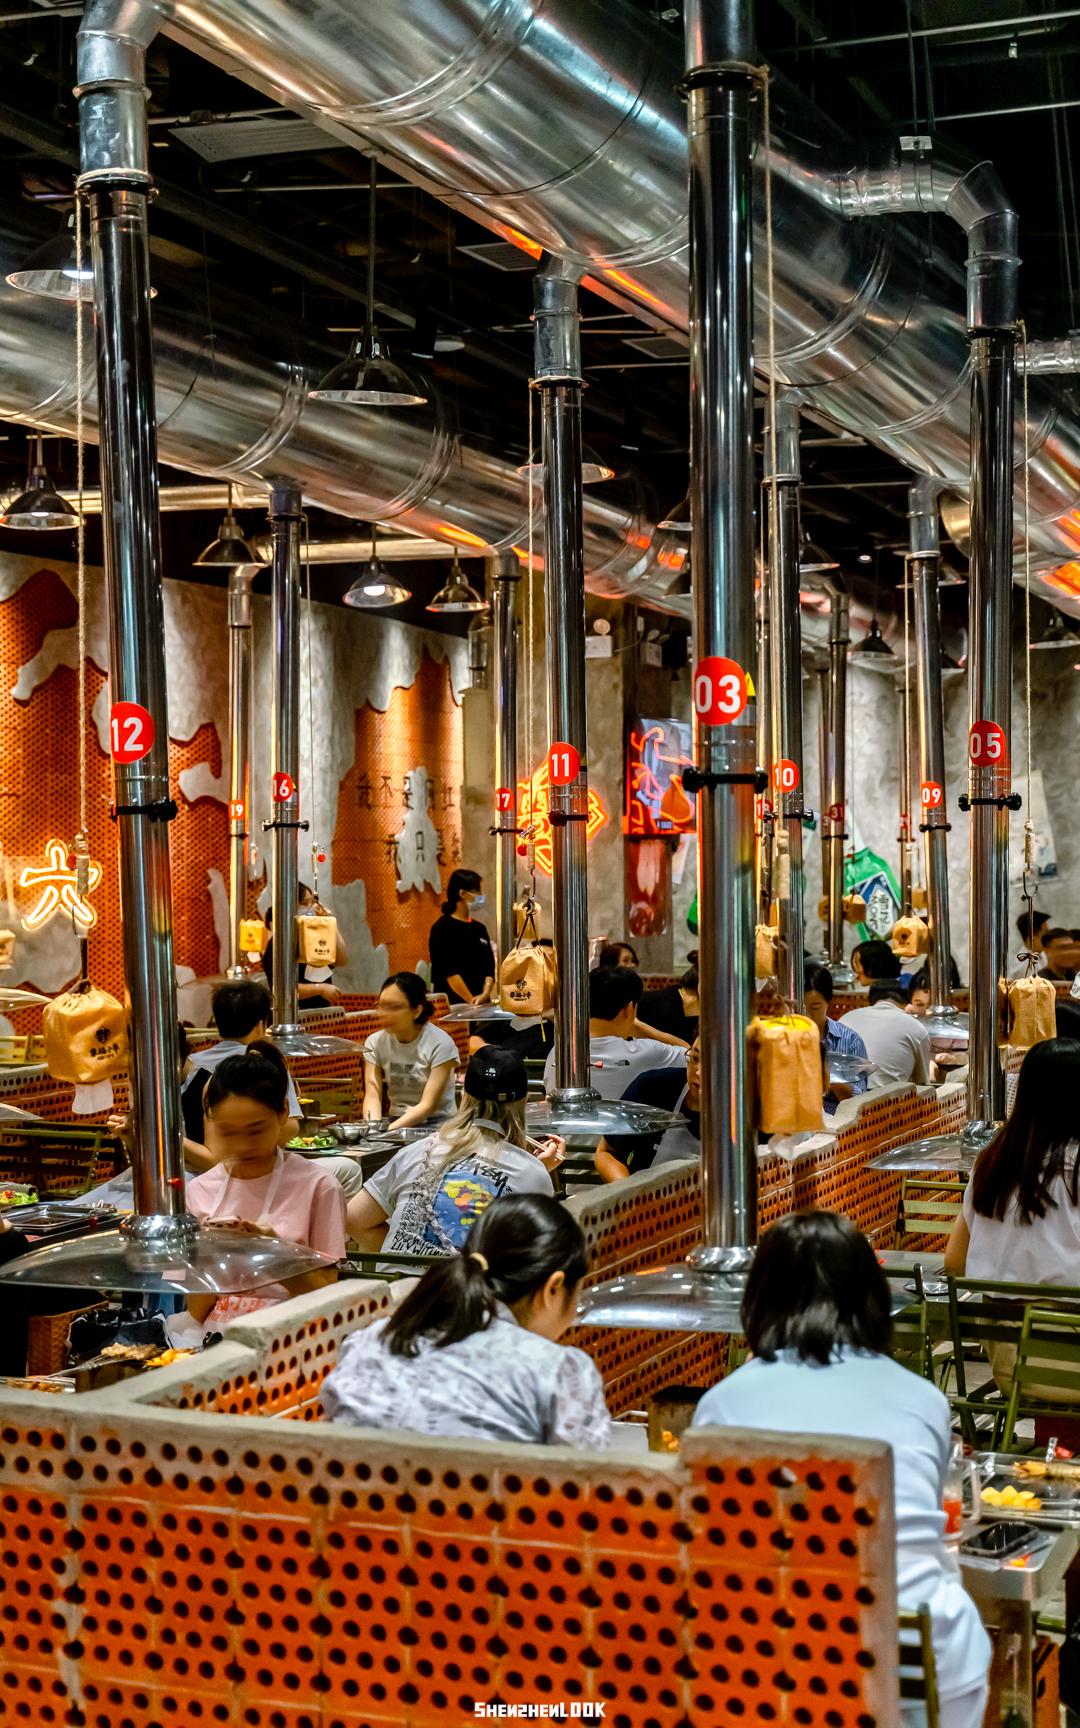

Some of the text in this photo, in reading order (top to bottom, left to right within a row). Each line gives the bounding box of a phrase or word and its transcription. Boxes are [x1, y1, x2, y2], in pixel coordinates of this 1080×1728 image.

[695, 674, 741, 714] 03
[111, 716, 144, 752] 12
[970, 733, 1001, 758] 05
[551, 753, 570, 777] 11
[273, 779, 290, 797] 16
[775, 767, 795, 787] 10
[496, 793, 510, 808] 17
[922, 788, 941, 803] 09
[231, 804, 244, 816] 19
[20, 840, 102, 929] 六
